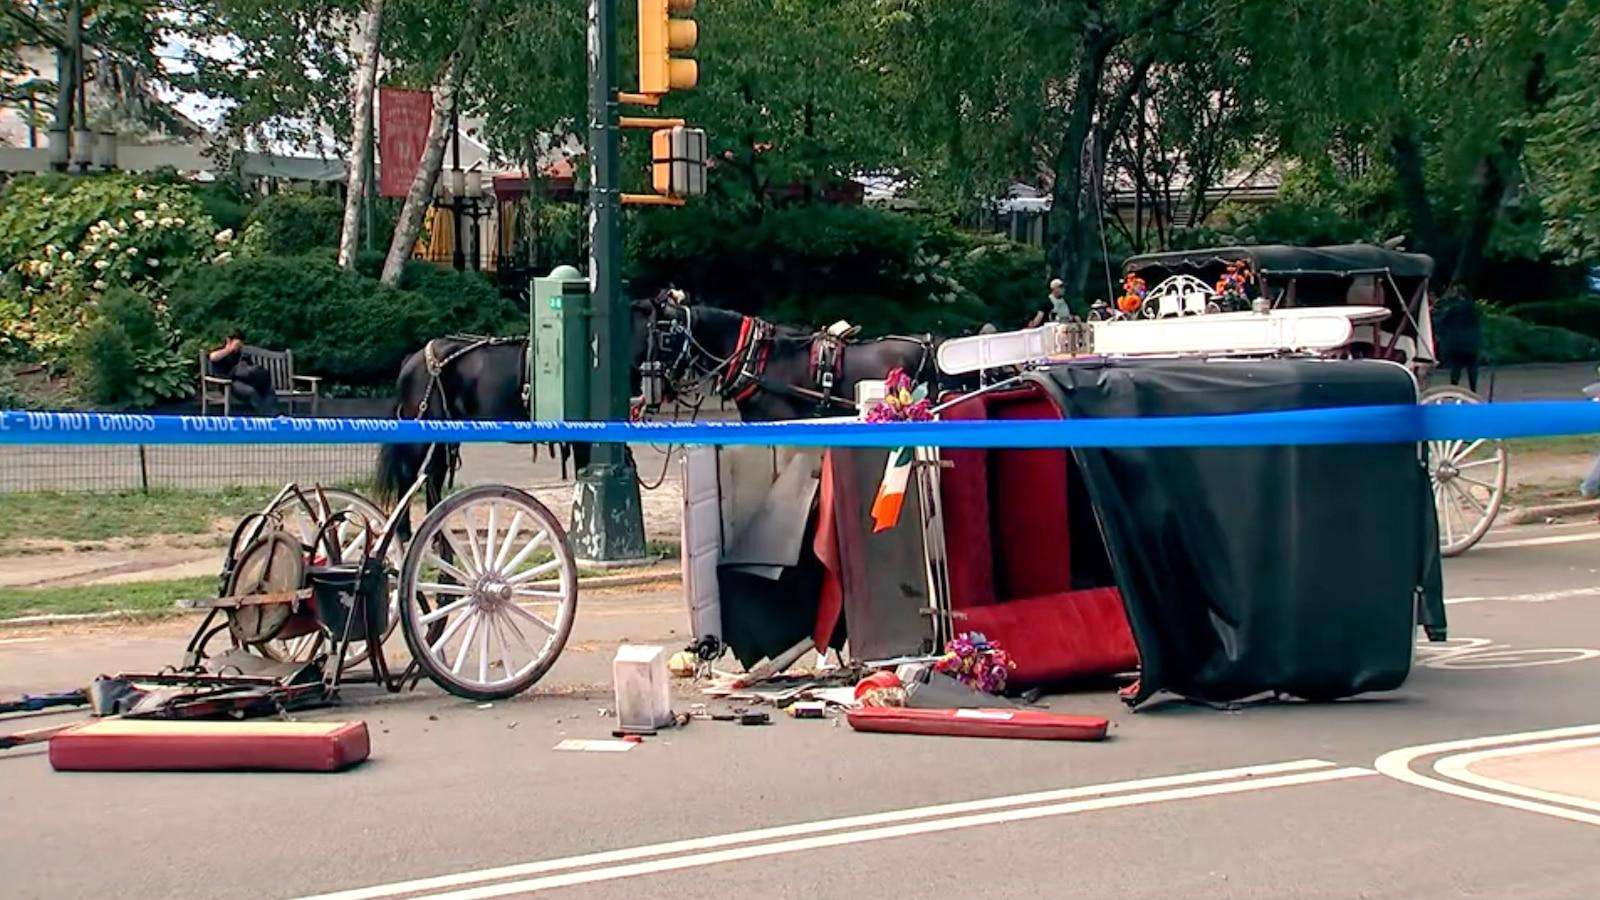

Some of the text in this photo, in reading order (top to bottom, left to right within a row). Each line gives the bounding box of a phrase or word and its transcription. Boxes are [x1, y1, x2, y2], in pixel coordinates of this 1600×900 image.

[28, 412, 52, 430] DO
[58, 413, 91, 431] NOT
[99, 414, 156, 432] CROSS
